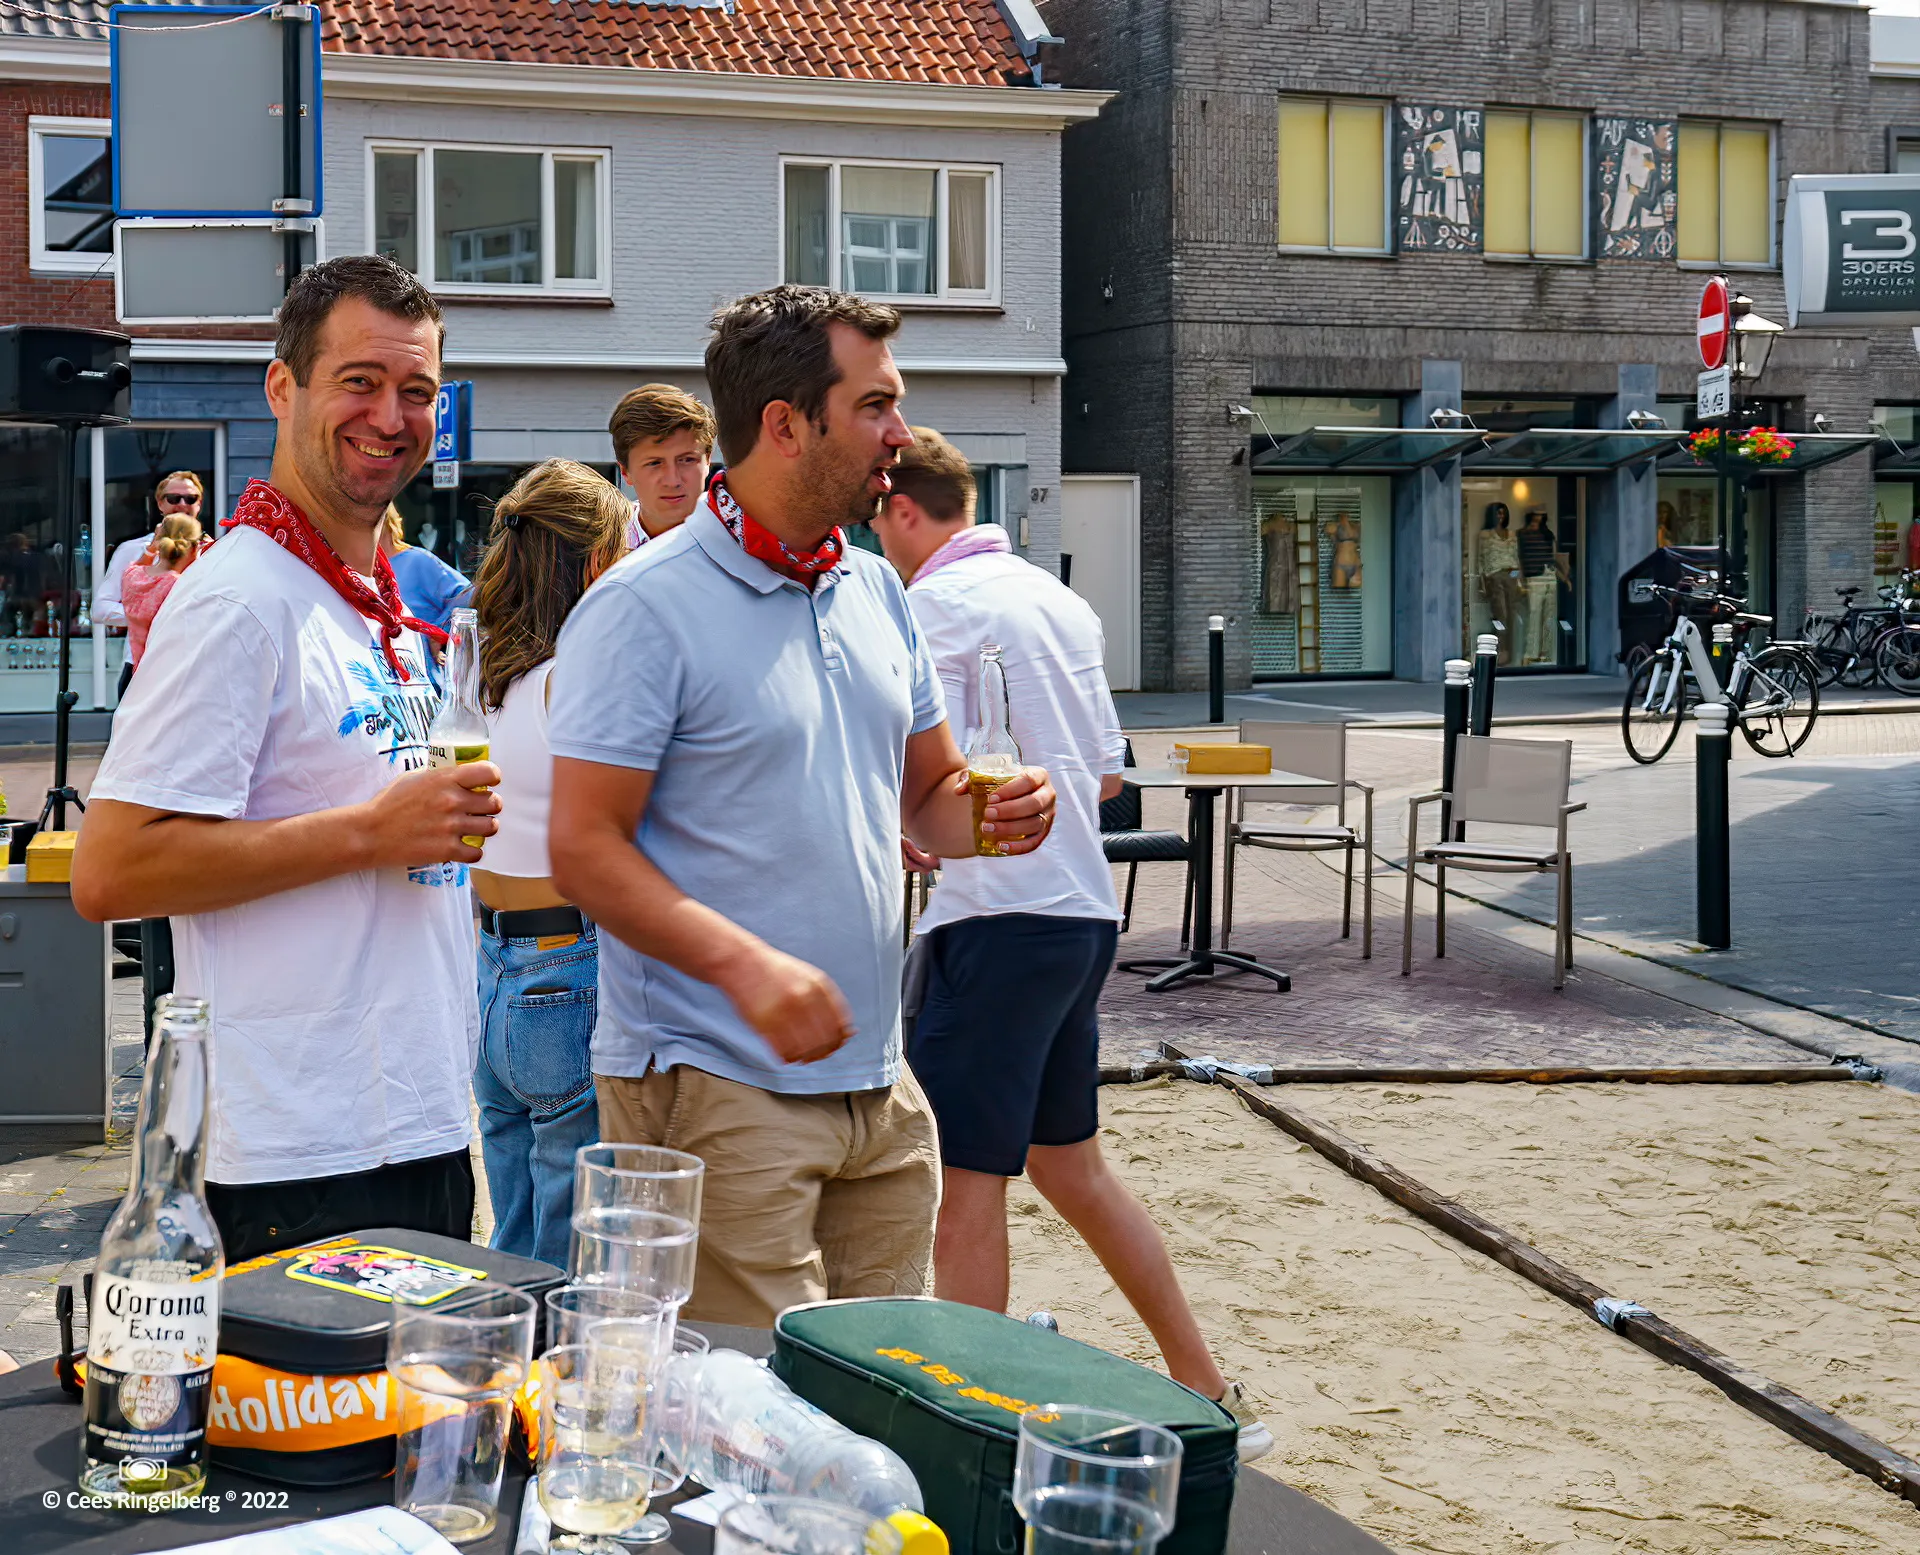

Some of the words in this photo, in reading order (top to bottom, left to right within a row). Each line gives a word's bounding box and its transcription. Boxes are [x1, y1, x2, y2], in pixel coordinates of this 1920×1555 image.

[438, 391, 450, 430] P
[105, 1283, 208, 1323] Corona
[129, 1318, 185, 1341] Extra
[206, 1374, 389, 1434] Holiday
